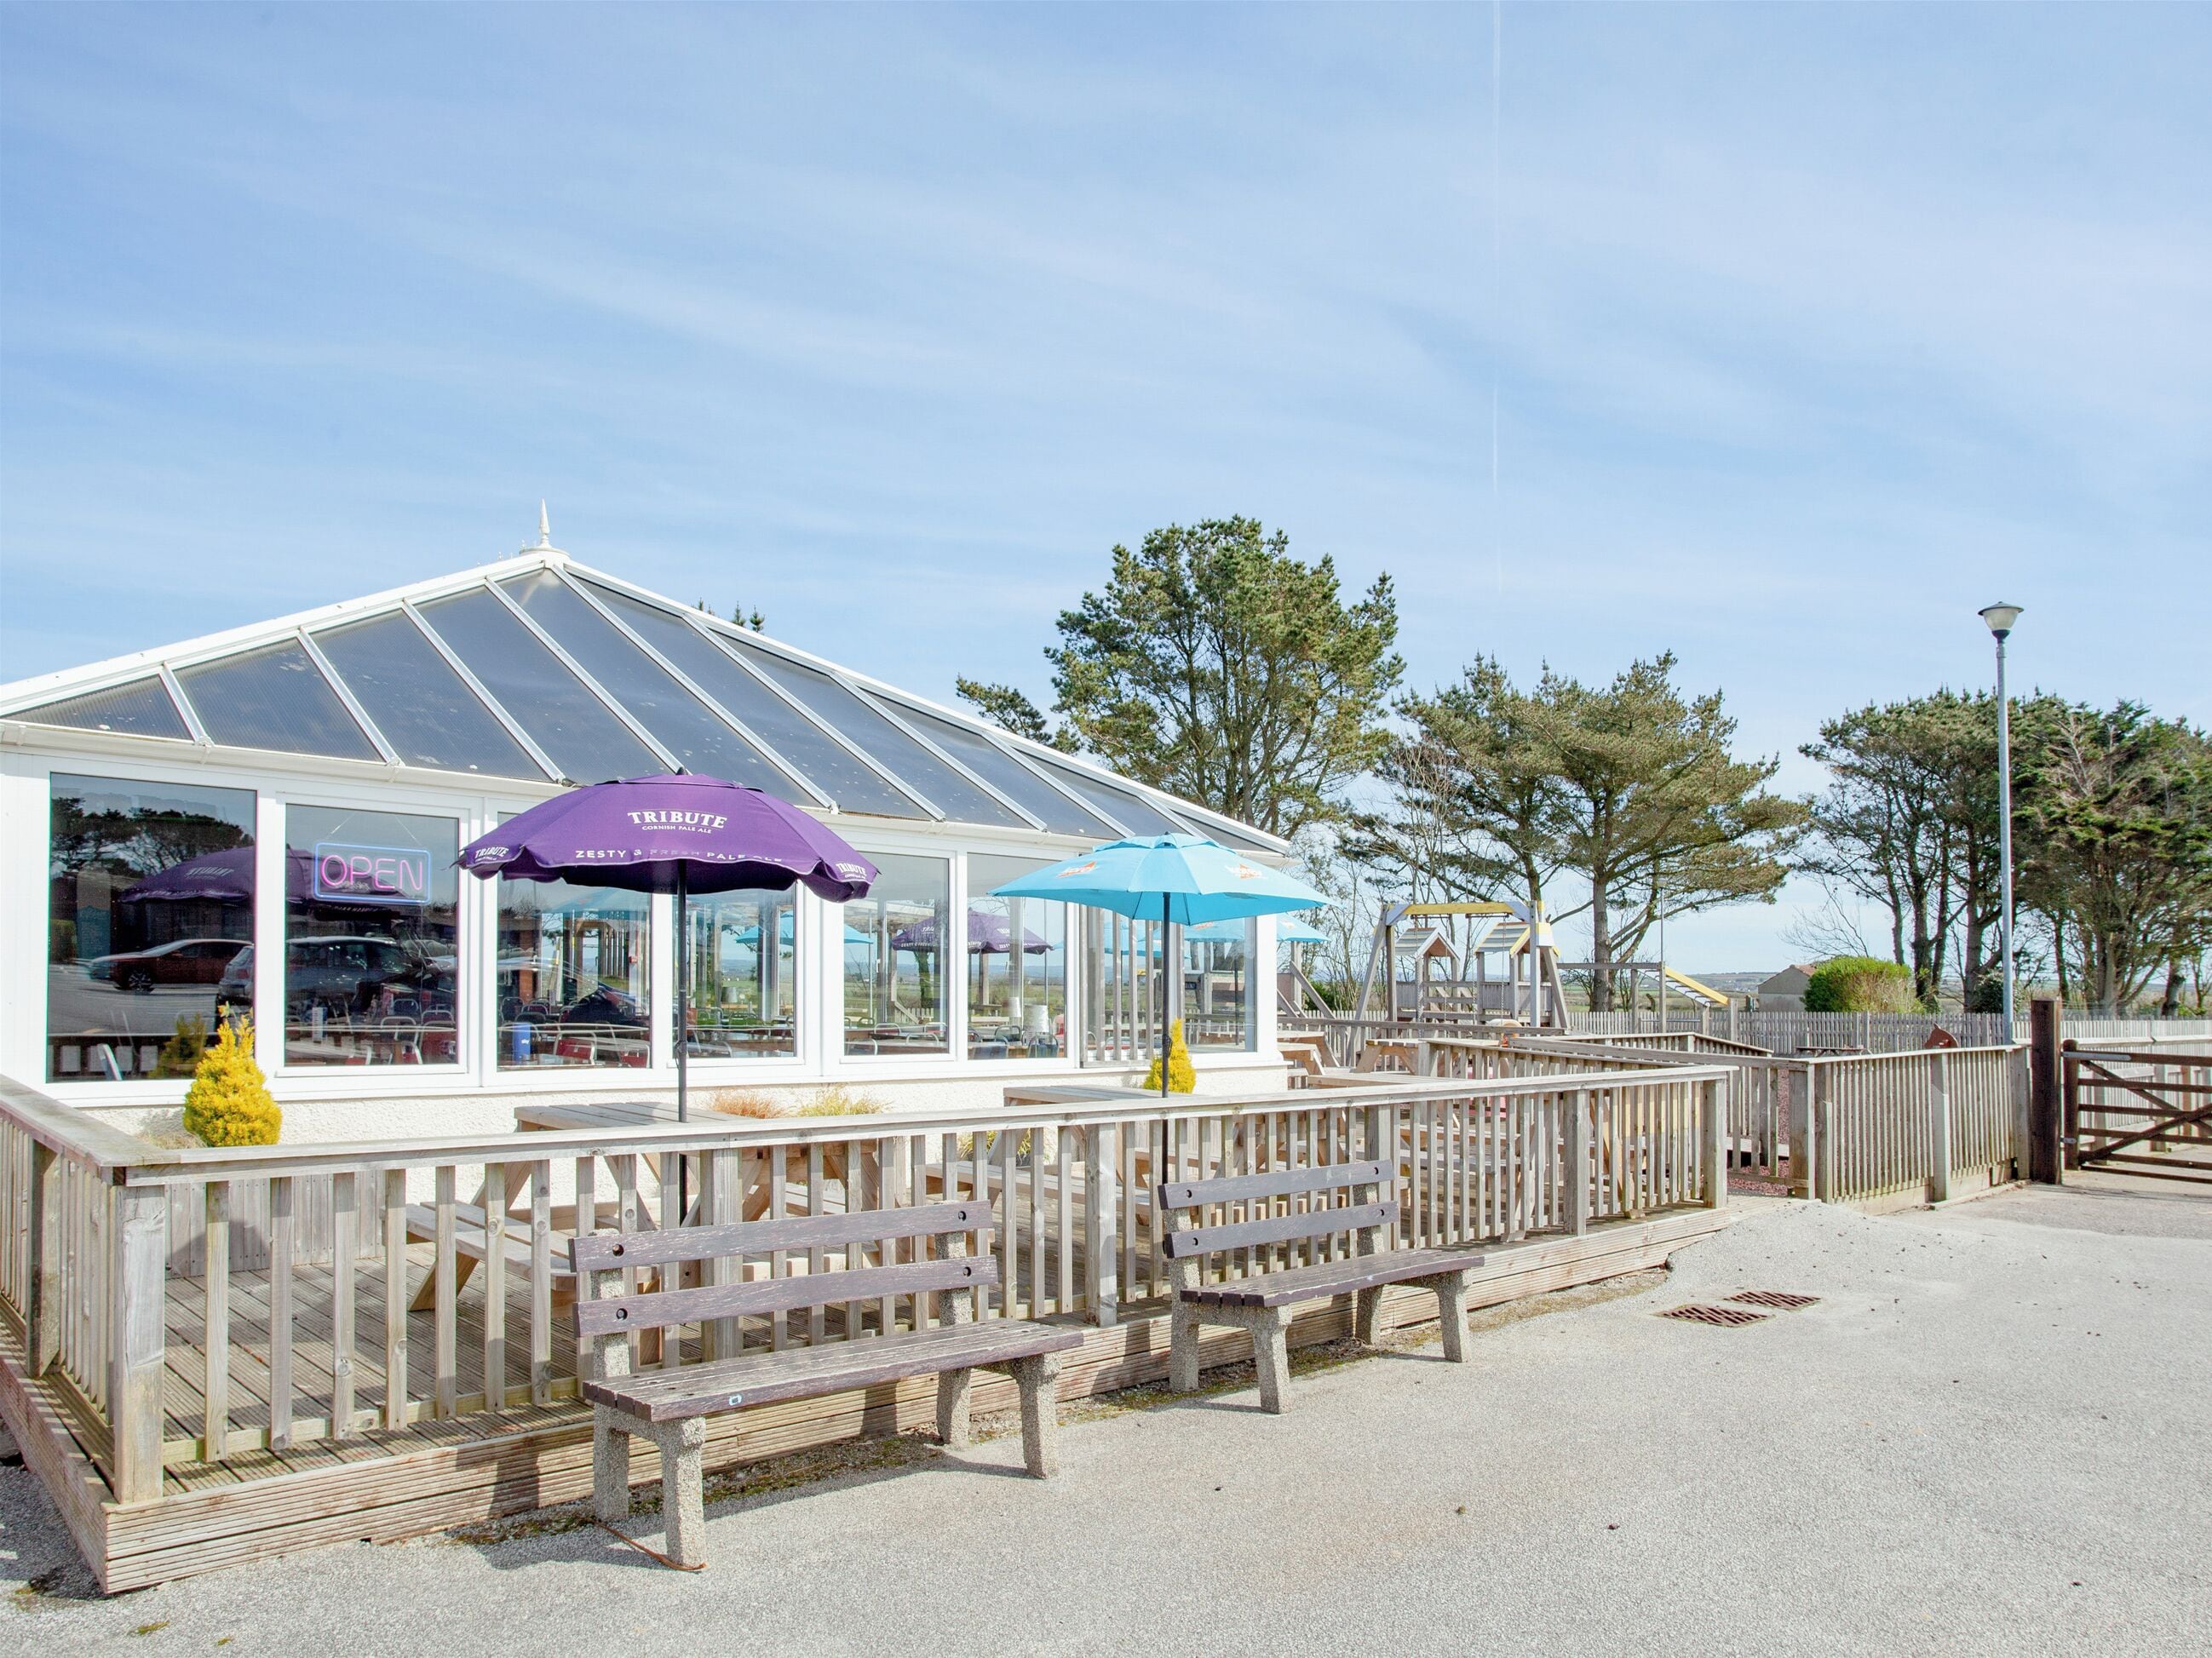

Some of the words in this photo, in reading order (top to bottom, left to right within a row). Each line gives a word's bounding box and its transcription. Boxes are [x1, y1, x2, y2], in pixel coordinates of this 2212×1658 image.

[627, 811, 728, 829] TRIBUTE
[474, 846, 509, 858] TRIBUTE
[576, 850, 627, 858] ZESTY
[319, 854, 423, 892] OPEN
[836, 863, 867, 877] TRIBUTE
